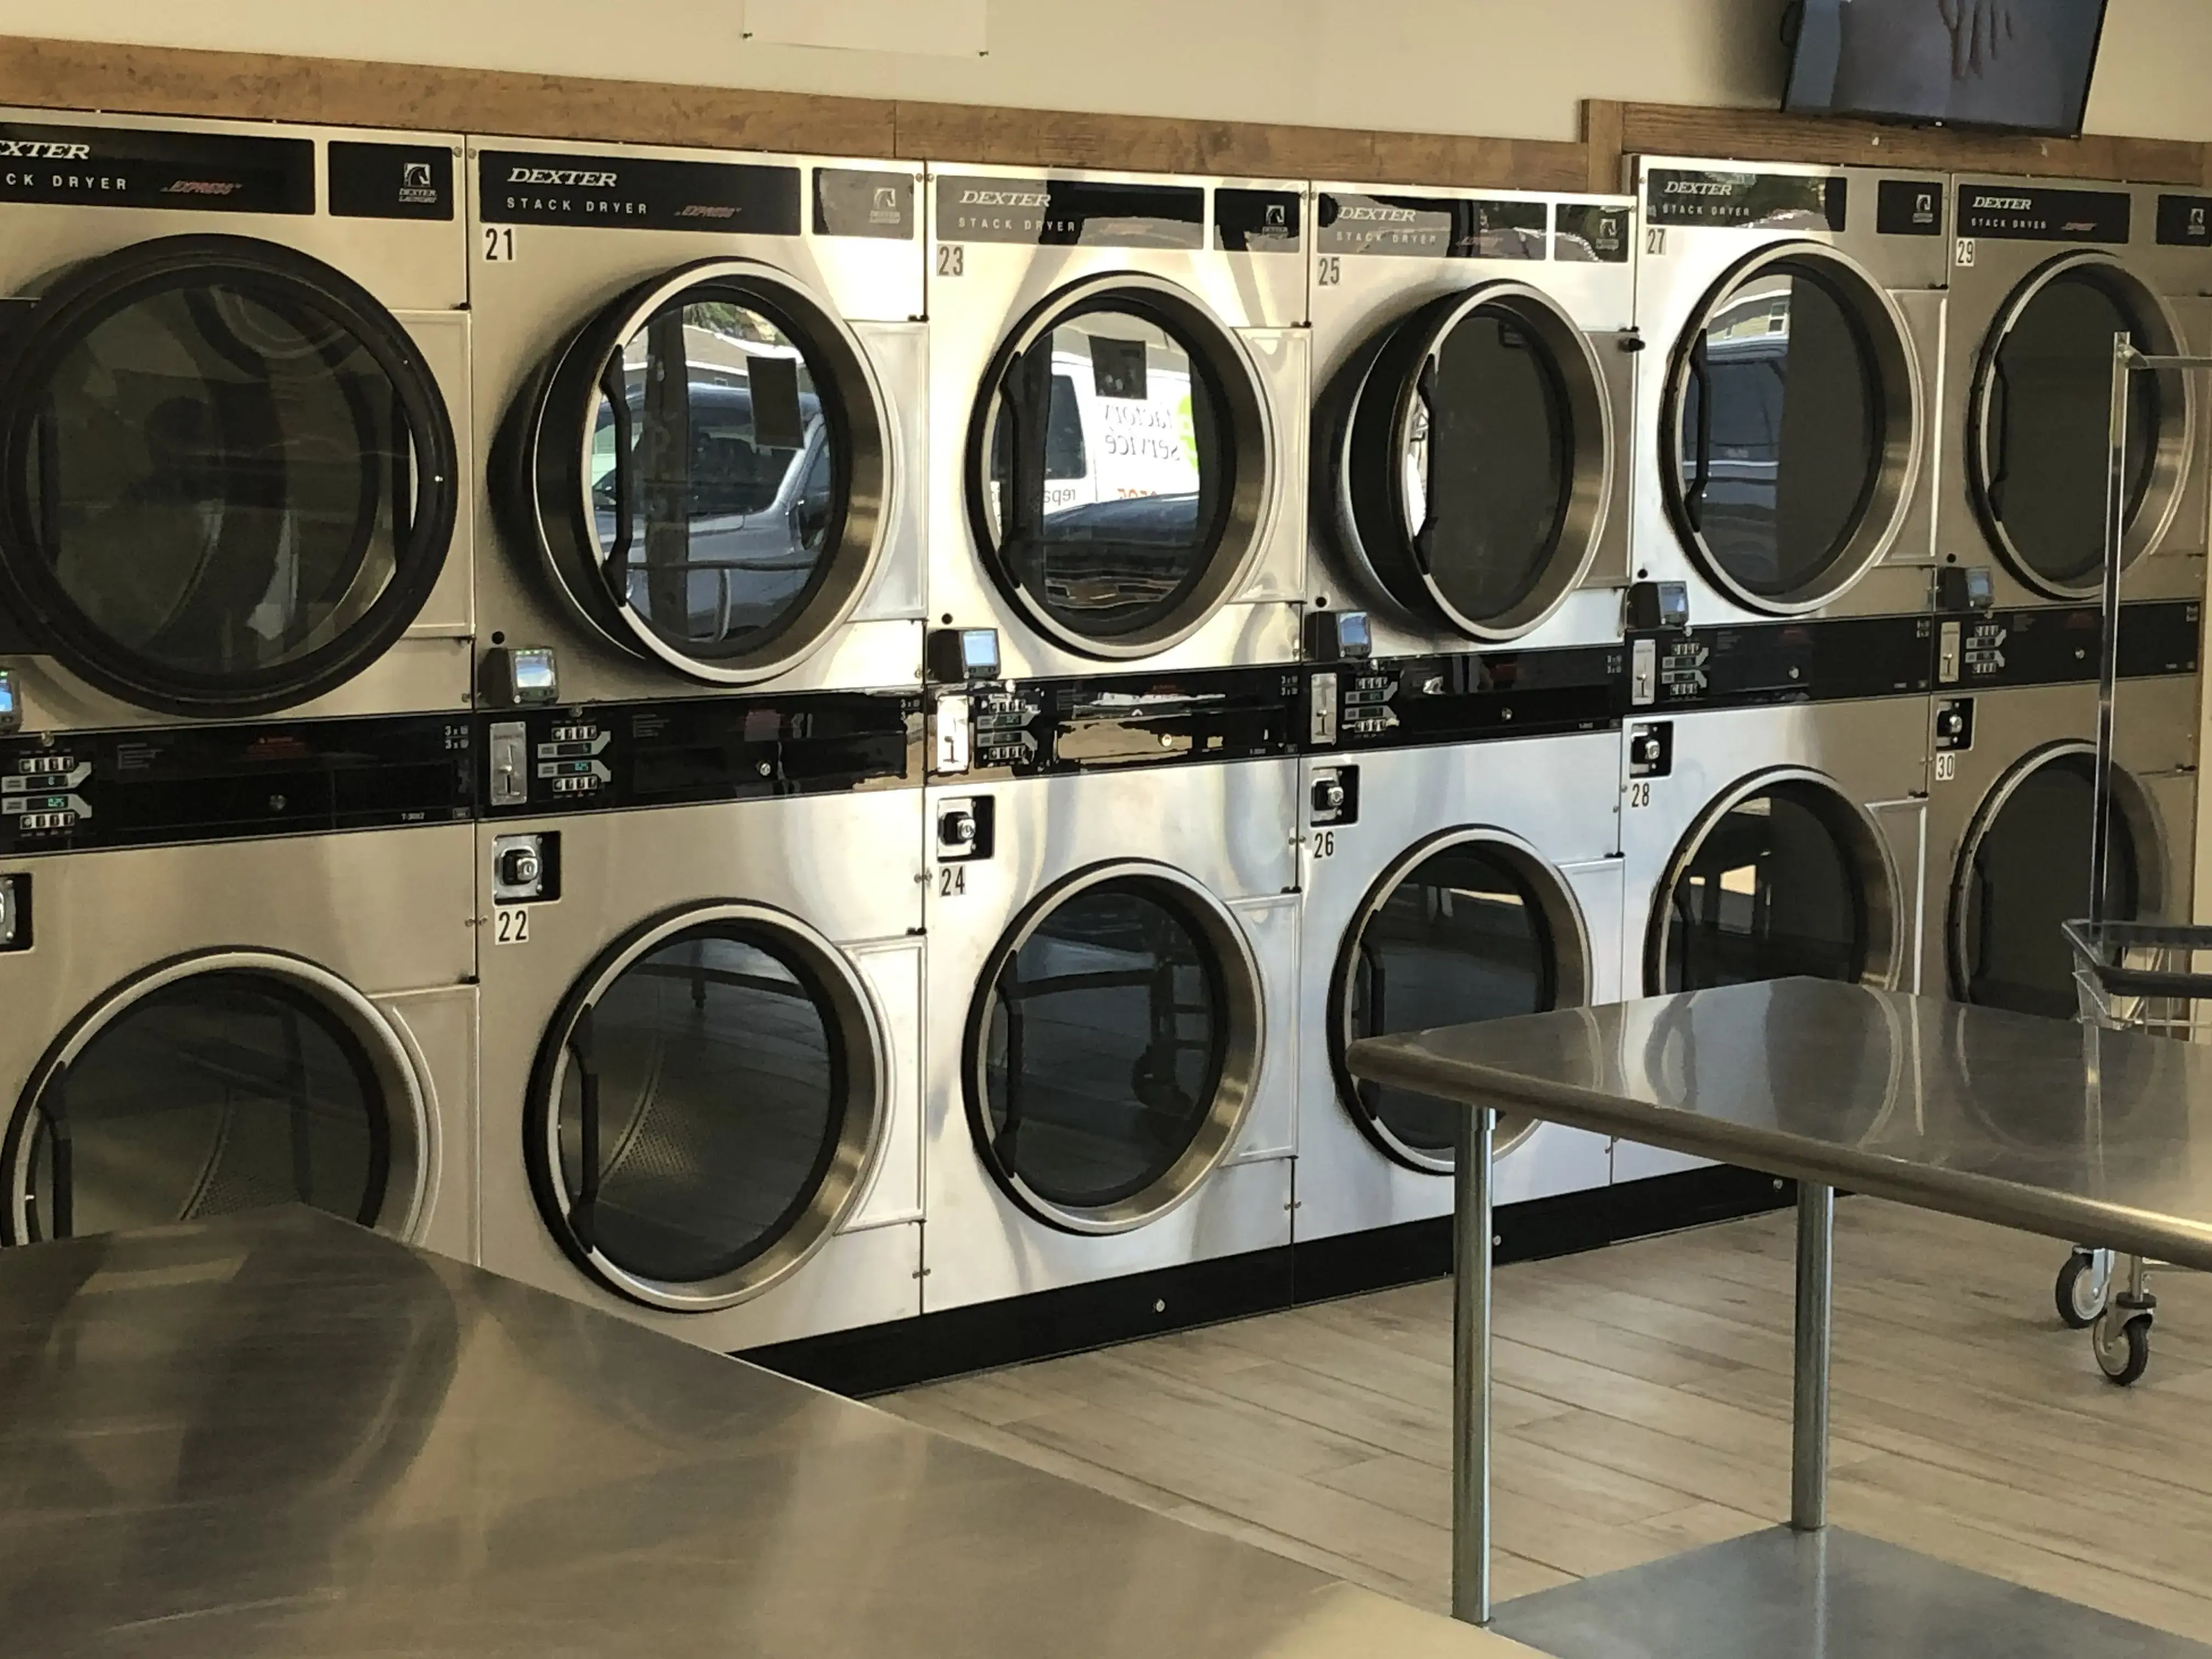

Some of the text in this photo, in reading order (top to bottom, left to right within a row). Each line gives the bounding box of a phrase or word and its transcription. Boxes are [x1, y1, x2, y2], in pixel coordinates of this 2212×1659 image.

[53, 175, 126, 190] DRYER
[507, 167, 618, 187] DEXTER
[1664, 180, 1733, 196] DEXTER
[507, 197, 647, 215] STACK DRYER
[959, 190, 1052, 207] DEXTER
[1972, 196, 2032, 210] DEXTER
[958, 217, 1075, 232] STACK DRYER
[1339, 206, 1417, 223] DEXTER
[485, 228, 513, 261] 21
[1336, 231, 1437, 245] STACK DRYER
[1647, 228, 1666, 255] 27
[938, 246, 964, 276] 23
[1957, 240, 1973, 263] 29
[1319, 257, 1340, 286] 25
[1938, 755, 1954, 778] 30
[1632, 783, 1650, 808] 28
[1314, 831, 1334, 859] 26
[941, 866, 965, 896] 24
[498, 910, 527, 943] 22
